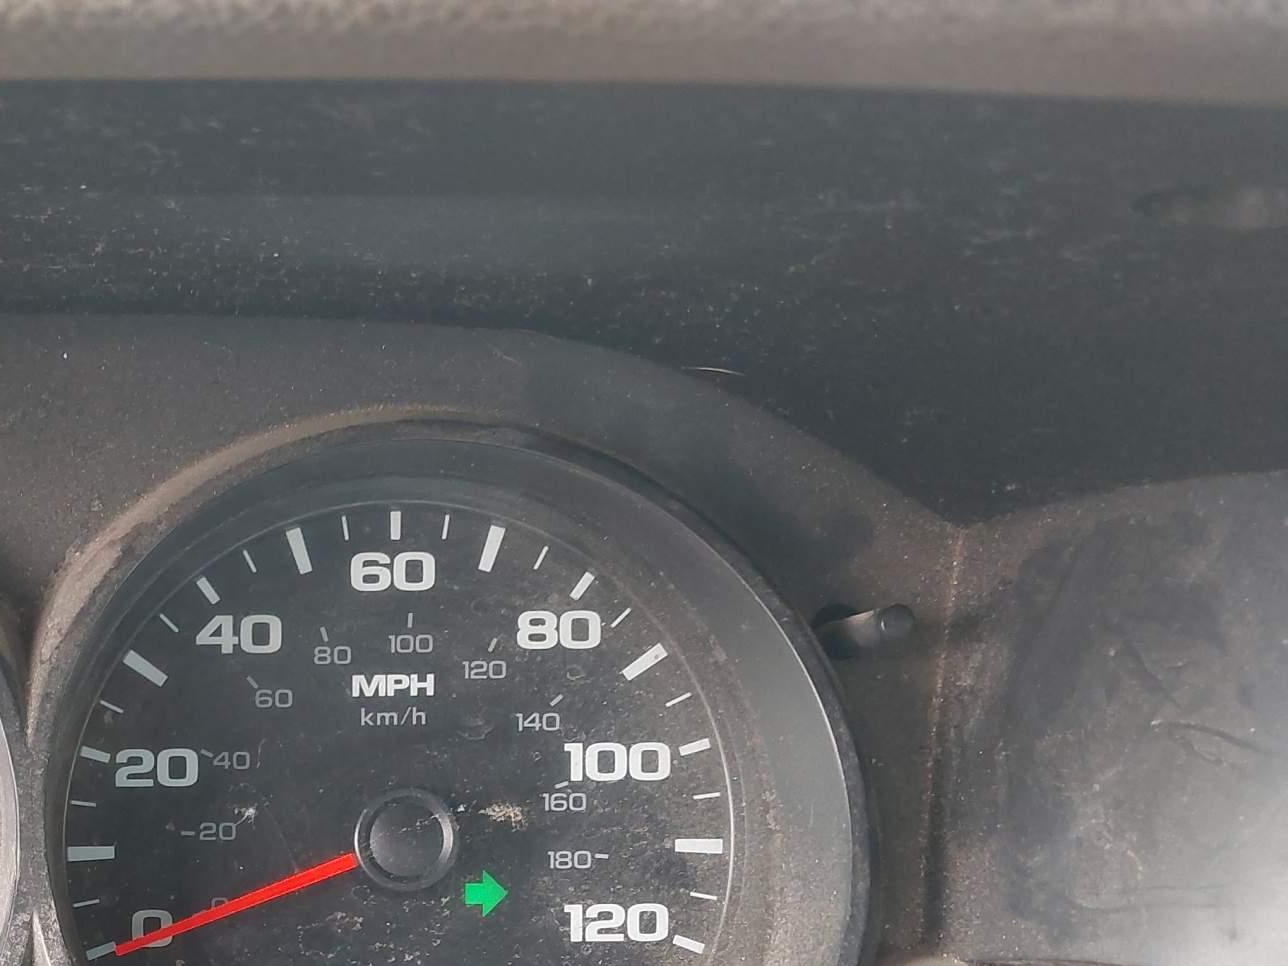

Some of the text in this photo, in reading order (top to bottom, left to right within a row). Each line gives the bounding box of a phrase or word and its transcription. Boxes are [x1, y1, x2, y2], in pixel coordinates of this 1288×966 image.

[350, 551, 436, 592] 60
[195, 614, 283, 654] 40
[517, 610, 601, 650] 80
[388, 635, 433, 654] 100
[314, 645, 352, 665] 80
[463, 660, 506, 680] 120
[351, 673, 435, 697] MPH
[254, 689, 293, 708] 60
[360, 707, 427, 726] km/h
[516, 712, 560, 732] 140
[115, 748, 198, 788] 20
[213, 751, 251, 770] 40
[564, 742, 671, 782] 100
[542, 792, 586, 812] 160
[197, 822, 236, 841] 20
[548, 850, 591, 870] 180
[132, 910, 173, 947] 0
[564, 903, 670, 943] 120
